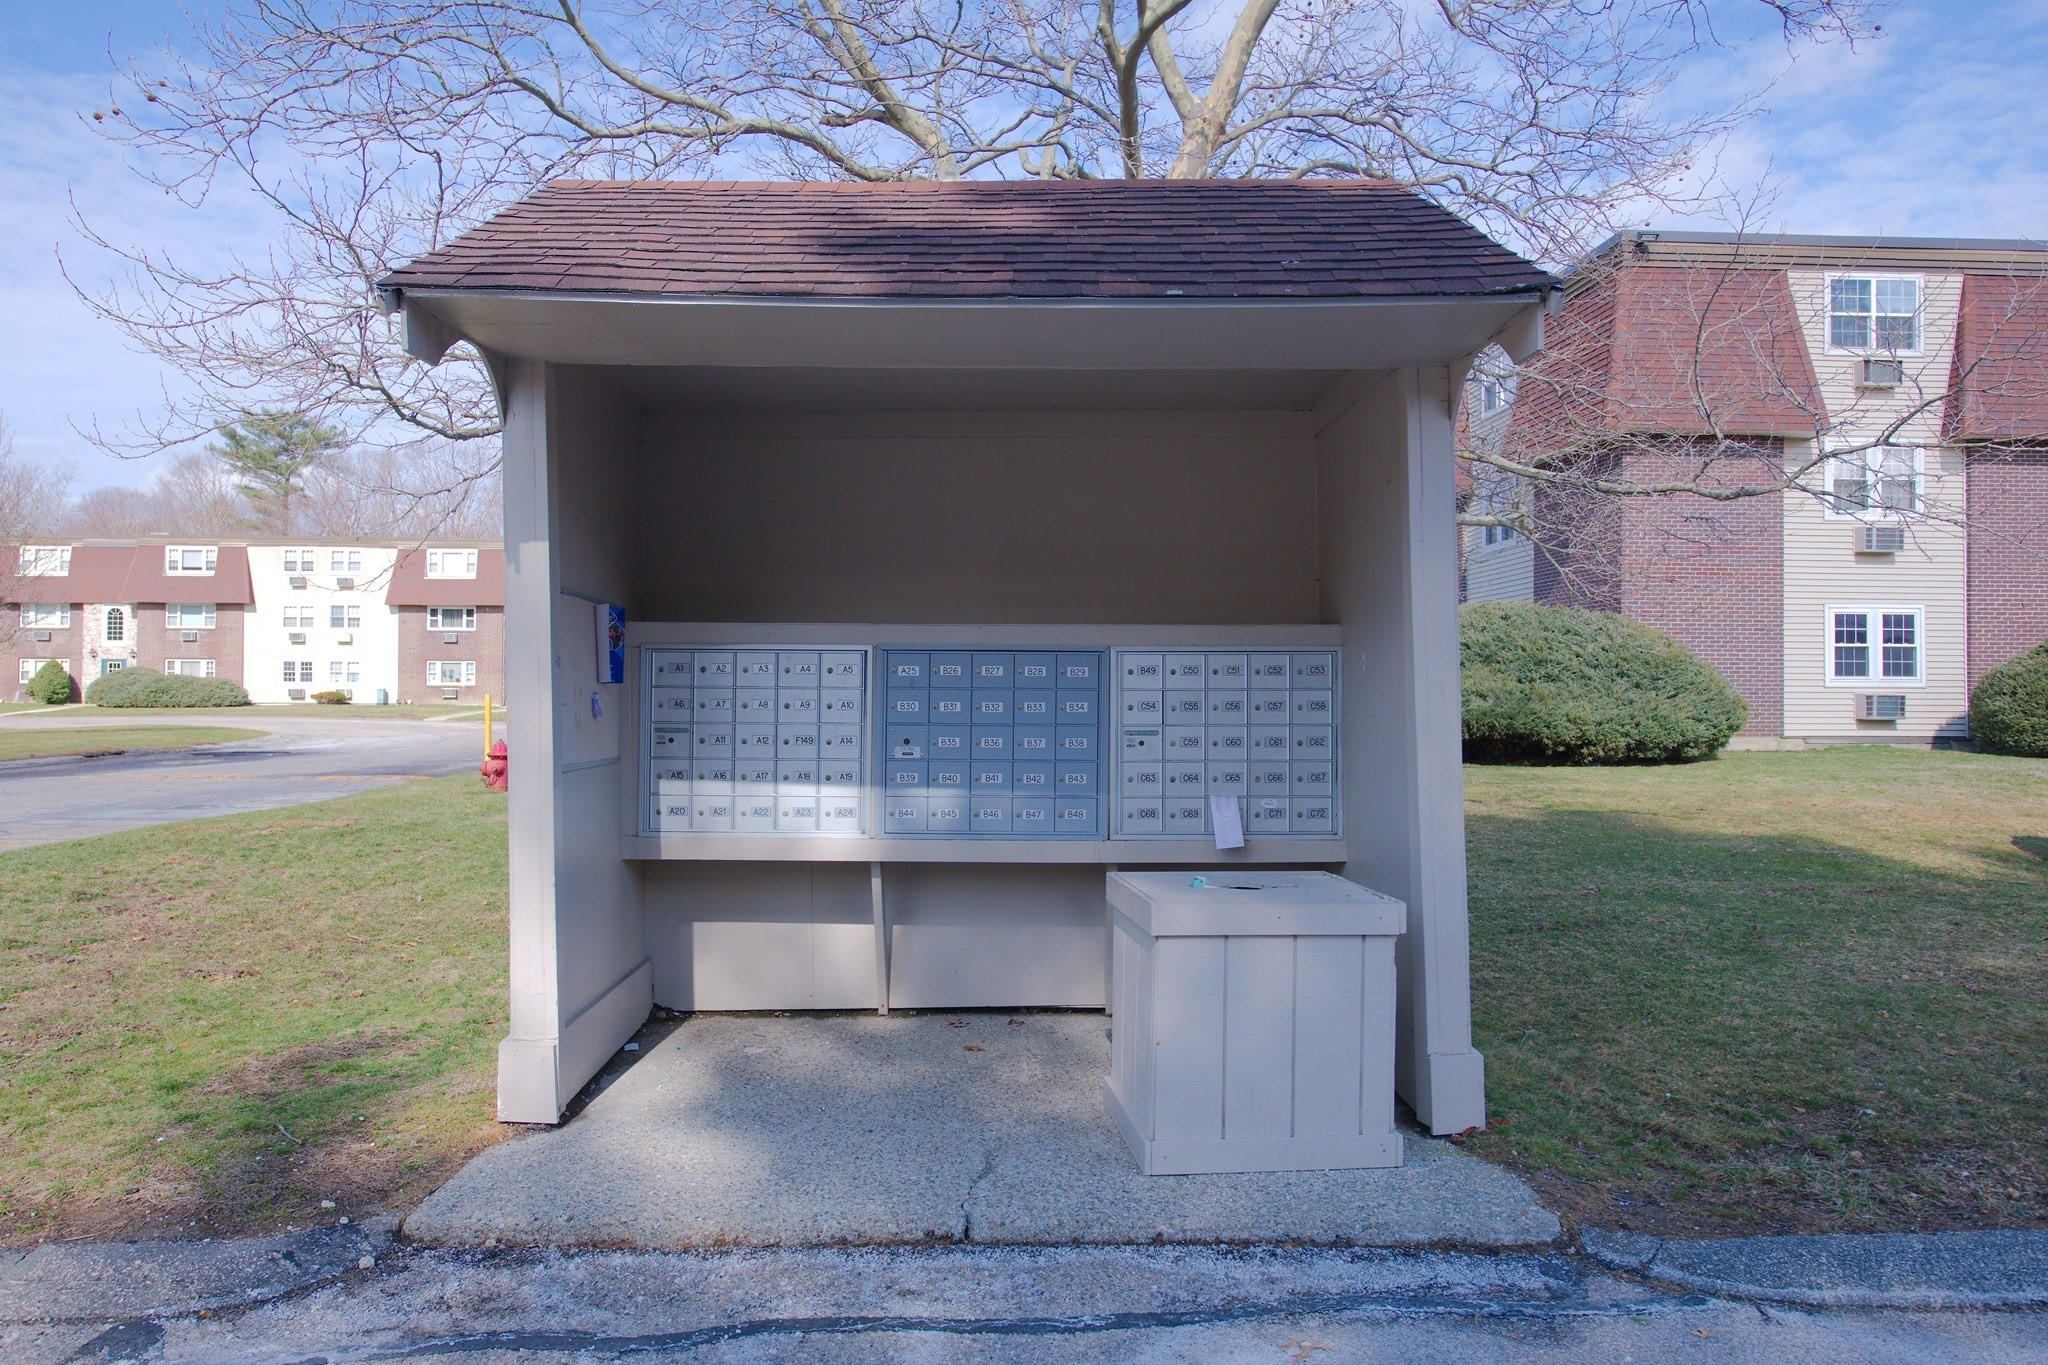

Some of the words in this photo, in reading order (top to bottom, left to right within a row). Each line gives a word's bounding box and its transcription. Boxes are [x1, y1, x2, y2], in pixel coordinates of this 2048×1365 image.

[716, 665, 727, 673] A2
[758, 665, 769, 673] A3
[800, 665, 811, 673] A4
[843, 665, 854, 673] A5
[900, 667, 917, 675] A25
[943, 667, 959, 675] B26
[985, 667, 1000, 675] B27
[1070, 668, 1086, 676] B29
[1140, 667, 1156, 675] B49
[1183, 666, 1199, 674] C50
[1267, 666, 1283, 675] C52
[1310, 666, 1325, 674] C53
[674, 700, 685, 708] A6
[715, 700, 726, 708] A7
[758, 700, 768, 708] A8
[800, 700, 810, 708] A9
[841, 701, 854, 709] A10
[900, 703, 916, 711] B30
[1069, 703, 1085, 711] B34
[1141, 702, 1156, 710] C54
[1183, 702, 1199, 710] C55
[1225, 702, 1241, 710] C56
[1268, 702, 1283, 710] C57
[1310, 702, 1326, 710] C58
[757, 736, 769, 744] A12
[795, 736, 814, 744] F149
[840, 737, 853, 745] A14
[941, 738, 957, 747] B35
[1027, 739, 1043, 747] B37
[1183, 738, 1199, 746] C59
[1225, 738, 1241, 746] C60
[1269, 738, 1283, 746] C61
[1309, 738, 1325, 746] C62
[671, 771, 684, 779] A15
[714, 772, 727, 780] A16
[756, 772, 768, 780] A17
[798, 772, 810, 780] A18
[899, 774, 915, 782] B39
[942, 774, 958, 783] B40
[985, 774, 999, 782] B41
[1026, 775, 1042, 783] B42
[1068, 775, 1084, 783] B43
[1140, 774, 1156, 782] C63
[1183, 773, 1199, 782] C64
[1225, 773, 1241, 781] C65
[1268, 773, 1283, 782] C66
[1310, 773, 1326, 782] C67
[670, 807, 685, 815] A20
[753, 808, 768, 816] A22
[796, 809, 811, 817] A23
[838, 809, 853, 817] A24
[899, 810, 914, 818] B44
[941, 810, 956, 818] B45
[1026, 811, 1041, 819] B47
[1140, 809, 1156, 818] C68
[1183, 810, 1198, 818] C69
[1269, 809, 1282, 817] C71
[1310, 809, 1325, 818] C72
